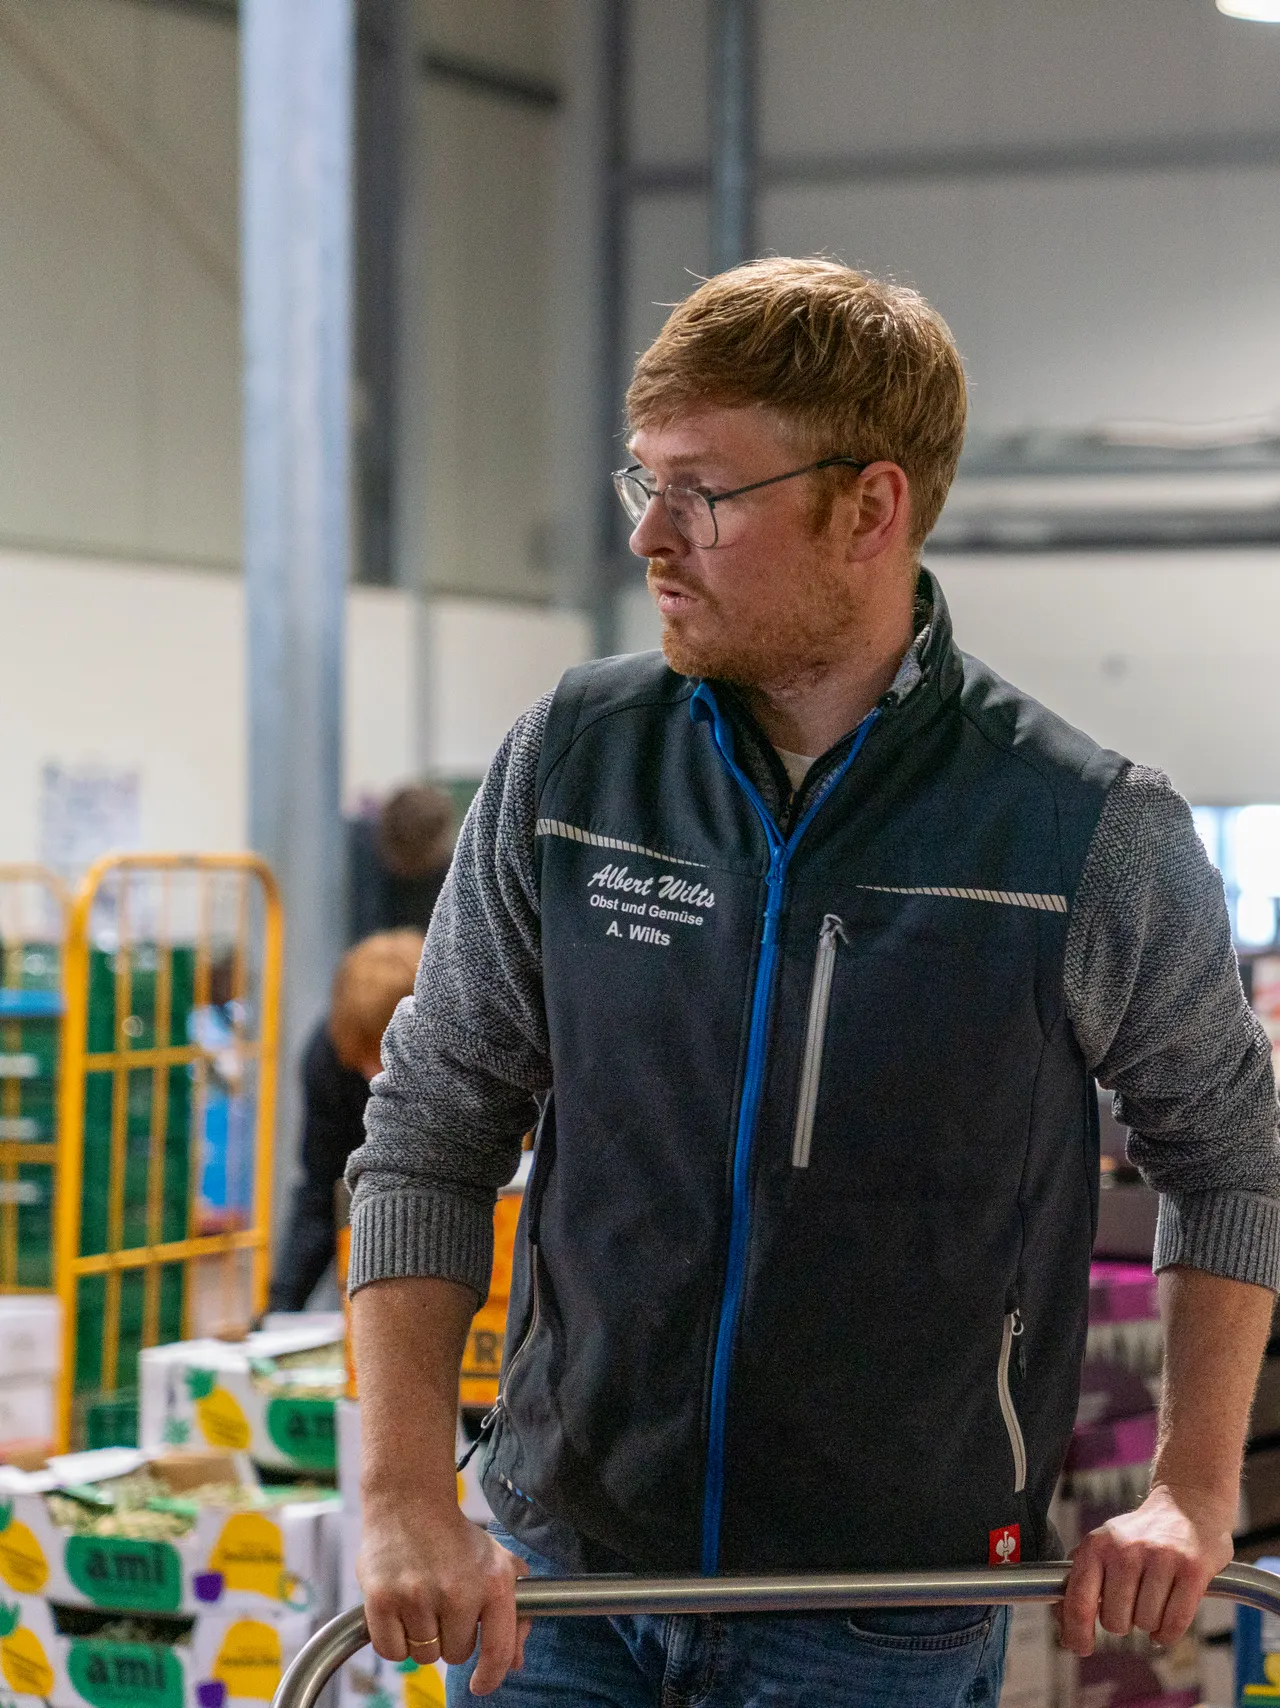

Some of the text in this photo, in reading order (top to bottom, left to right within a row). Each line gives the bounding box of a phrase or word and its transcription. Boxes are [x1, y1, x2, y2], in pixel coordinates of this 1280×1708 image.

[587, 863, 716, 908] Albert Wilts
[590, 894, 704, 926] Obst und Gemüse
[605, 920, 671, 946] A. Wilts
